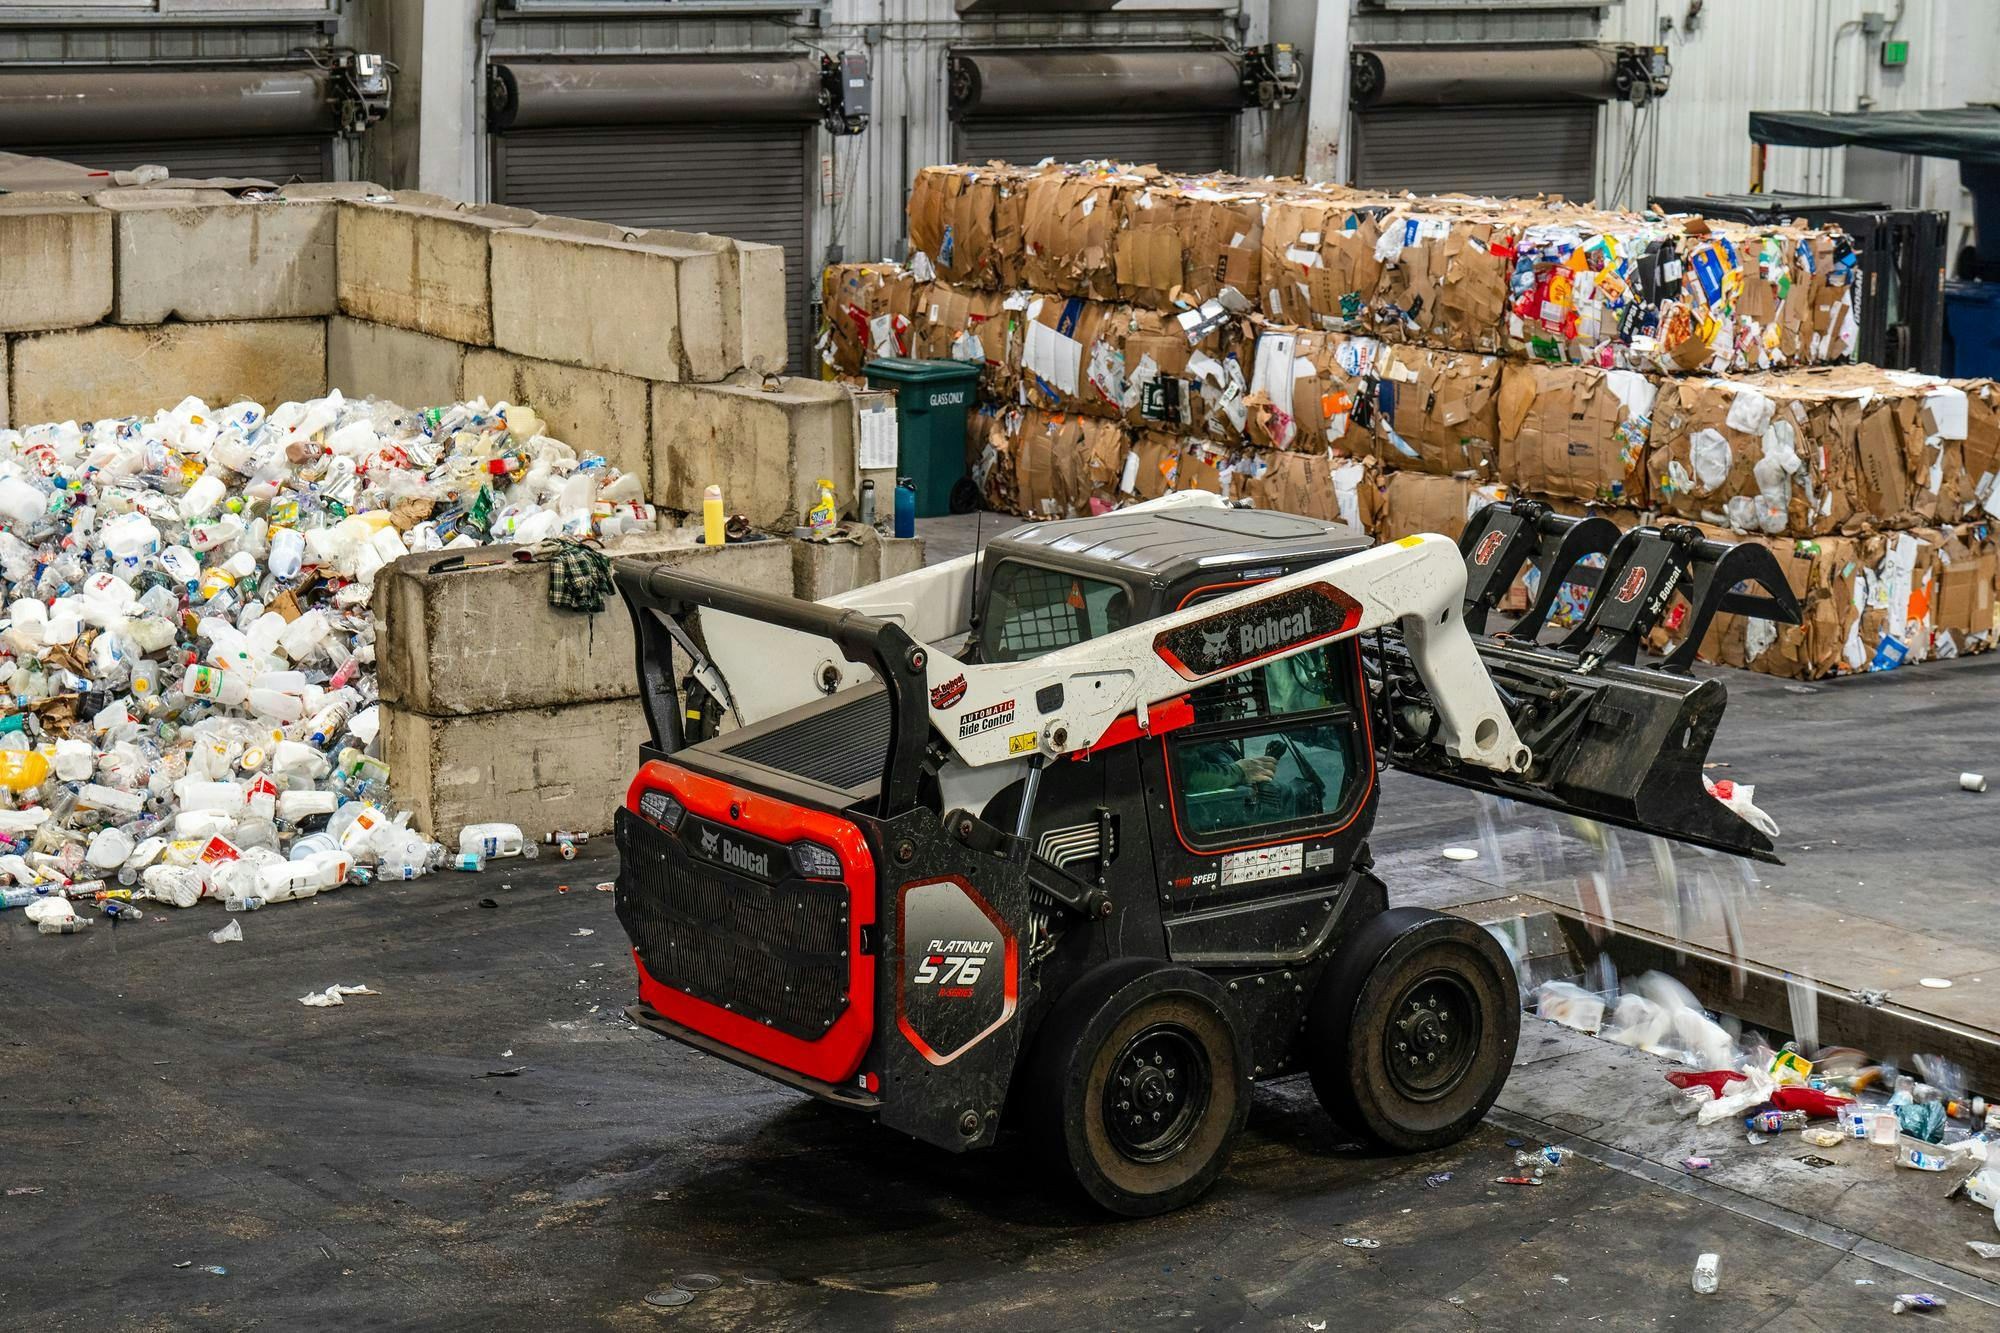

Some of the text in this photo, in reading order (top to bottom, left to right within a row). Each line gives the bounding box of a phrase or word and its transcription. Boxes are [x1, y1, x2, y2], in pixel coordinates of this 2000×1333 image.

[930, 391, 964, 406] GLASS ONLY
[1659, 565, 1682, 602] Bobcat
[1240, 606, 1313, 655] Bobcat
[940, 673, 965, 693] Bobcat
[959, 710, 1015, 738] Ride Control
[961, 700, 1014, 724] AUTOMATIC
[723, 839, 769, 877] Bobcat
[1192, 872, 1217, 886] SPEED
[927, 940, 994, 953] PLATINUM
[914, 956, 986, 985] S76
